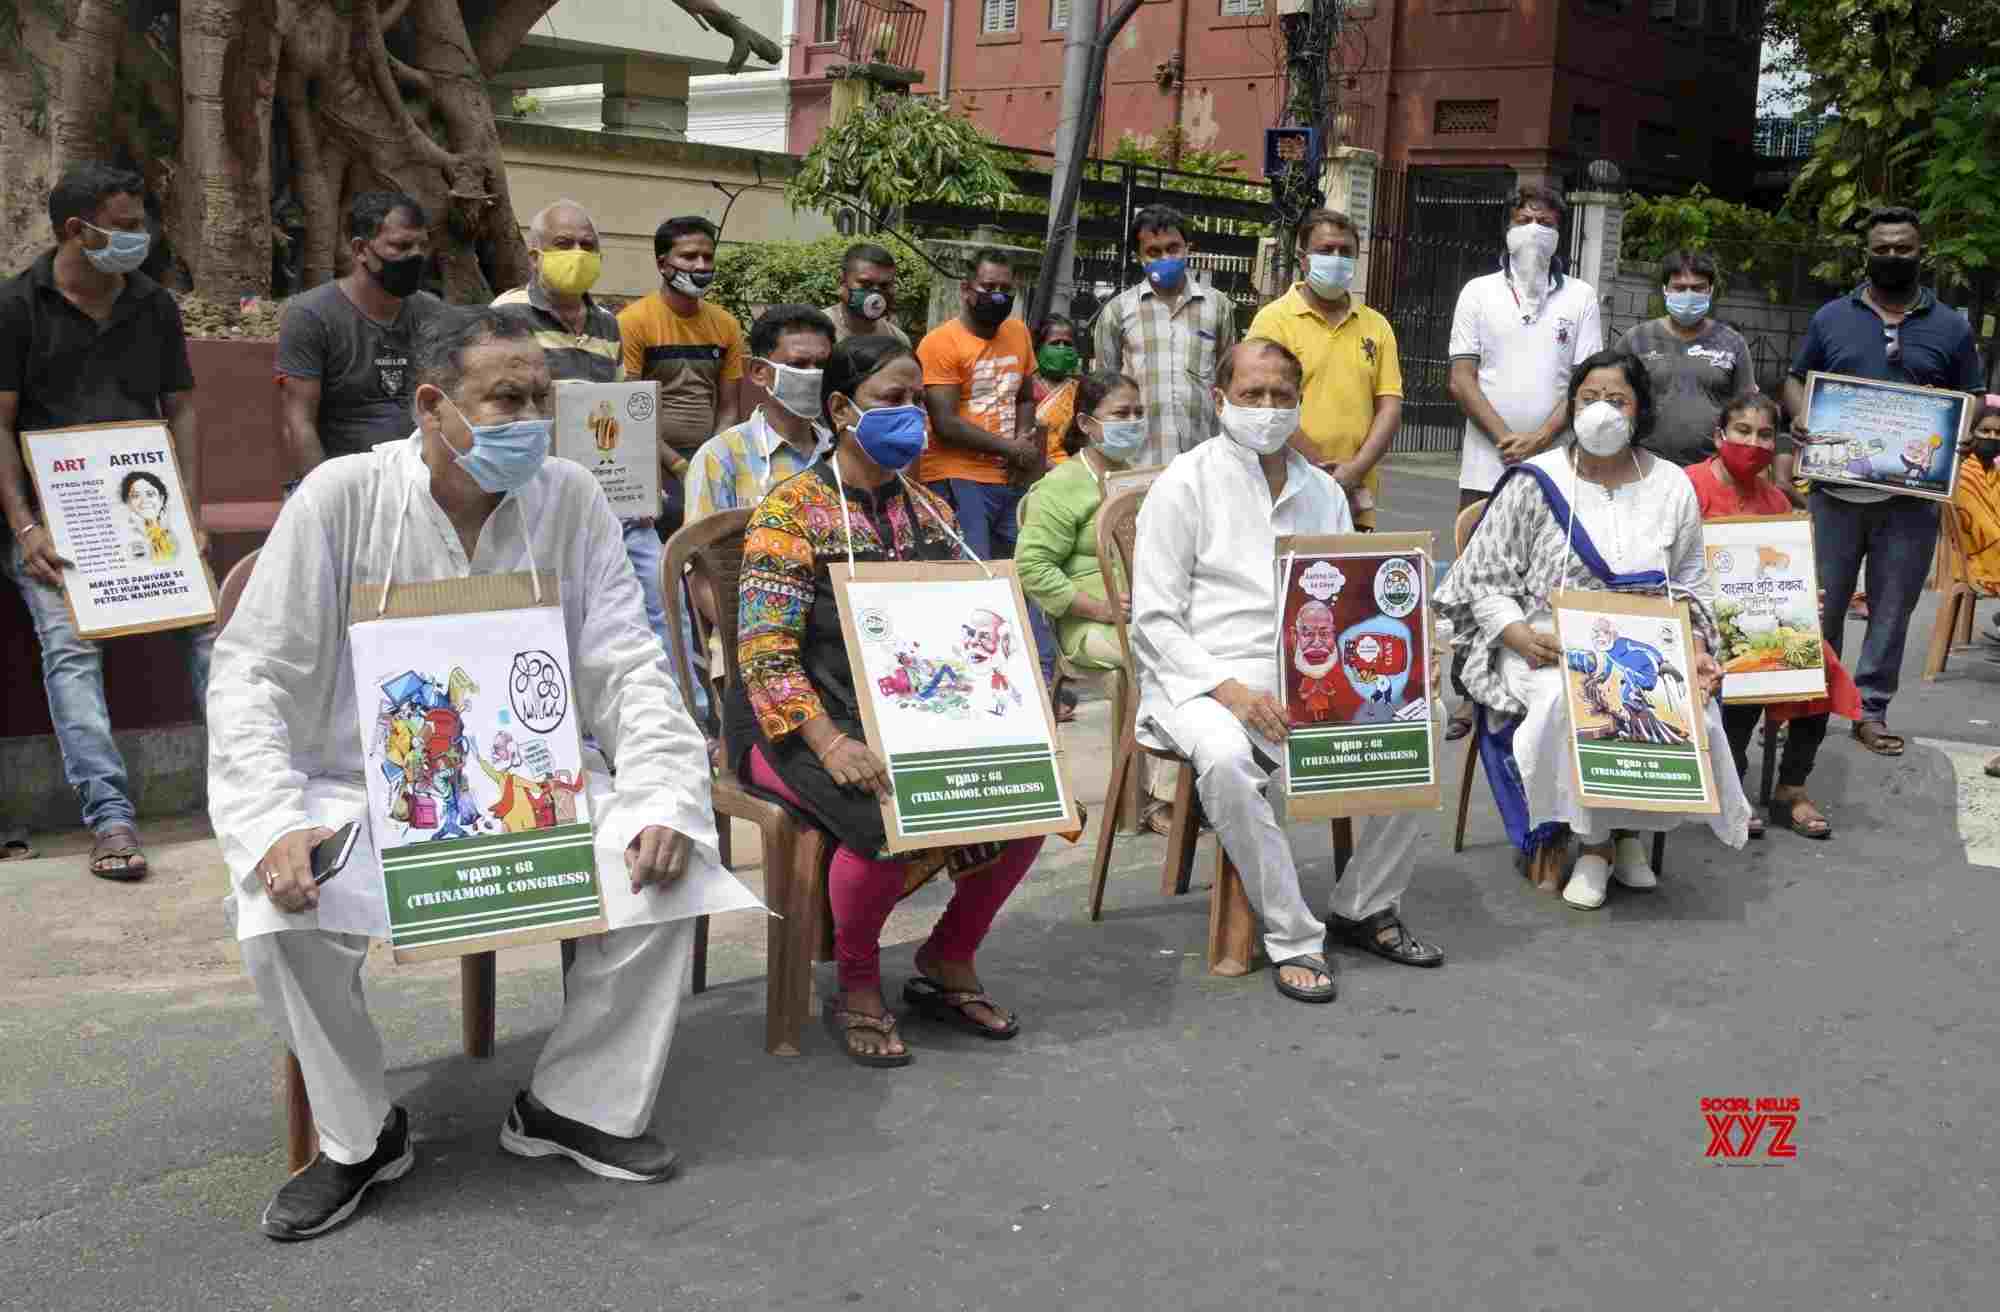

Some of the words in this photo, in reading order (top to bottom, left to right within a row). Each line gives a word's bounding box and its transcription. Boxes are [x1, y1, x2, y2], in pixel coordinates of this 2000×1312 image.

[53, 457, 86, 473] ART
[110, 450, 165, 467] ARTIST
[89, 580, 115, 589] MAIN
[116, 577, 129, 586] JIS
[131, 571, 171, 583] PARIVAR
[173, 569, 184, 578] SE
[103, 588, 119, 596] ATI
[120, 585, 140, 593] HUN
[143, 580, 176, 590] WAHAN
[94, 594, 130, 605] PETROL
[131, 590, 160, 600] NAHIN
[162, 585, 189, 595] PEETE
[945, 771, 980, 787] WARD
[988, 770, 1003, 782] 68
[911, 787, 982, 805] (TRINAMOOL
[983, 781, 1045, 797] CONGRESS)
[456, 865, 502, 884] WARD
[515, 860, 534, 875] 68
[407, 881, 505, 909] (TRINAMOOL
[507, 871, 591, 894] CONGRESS)
